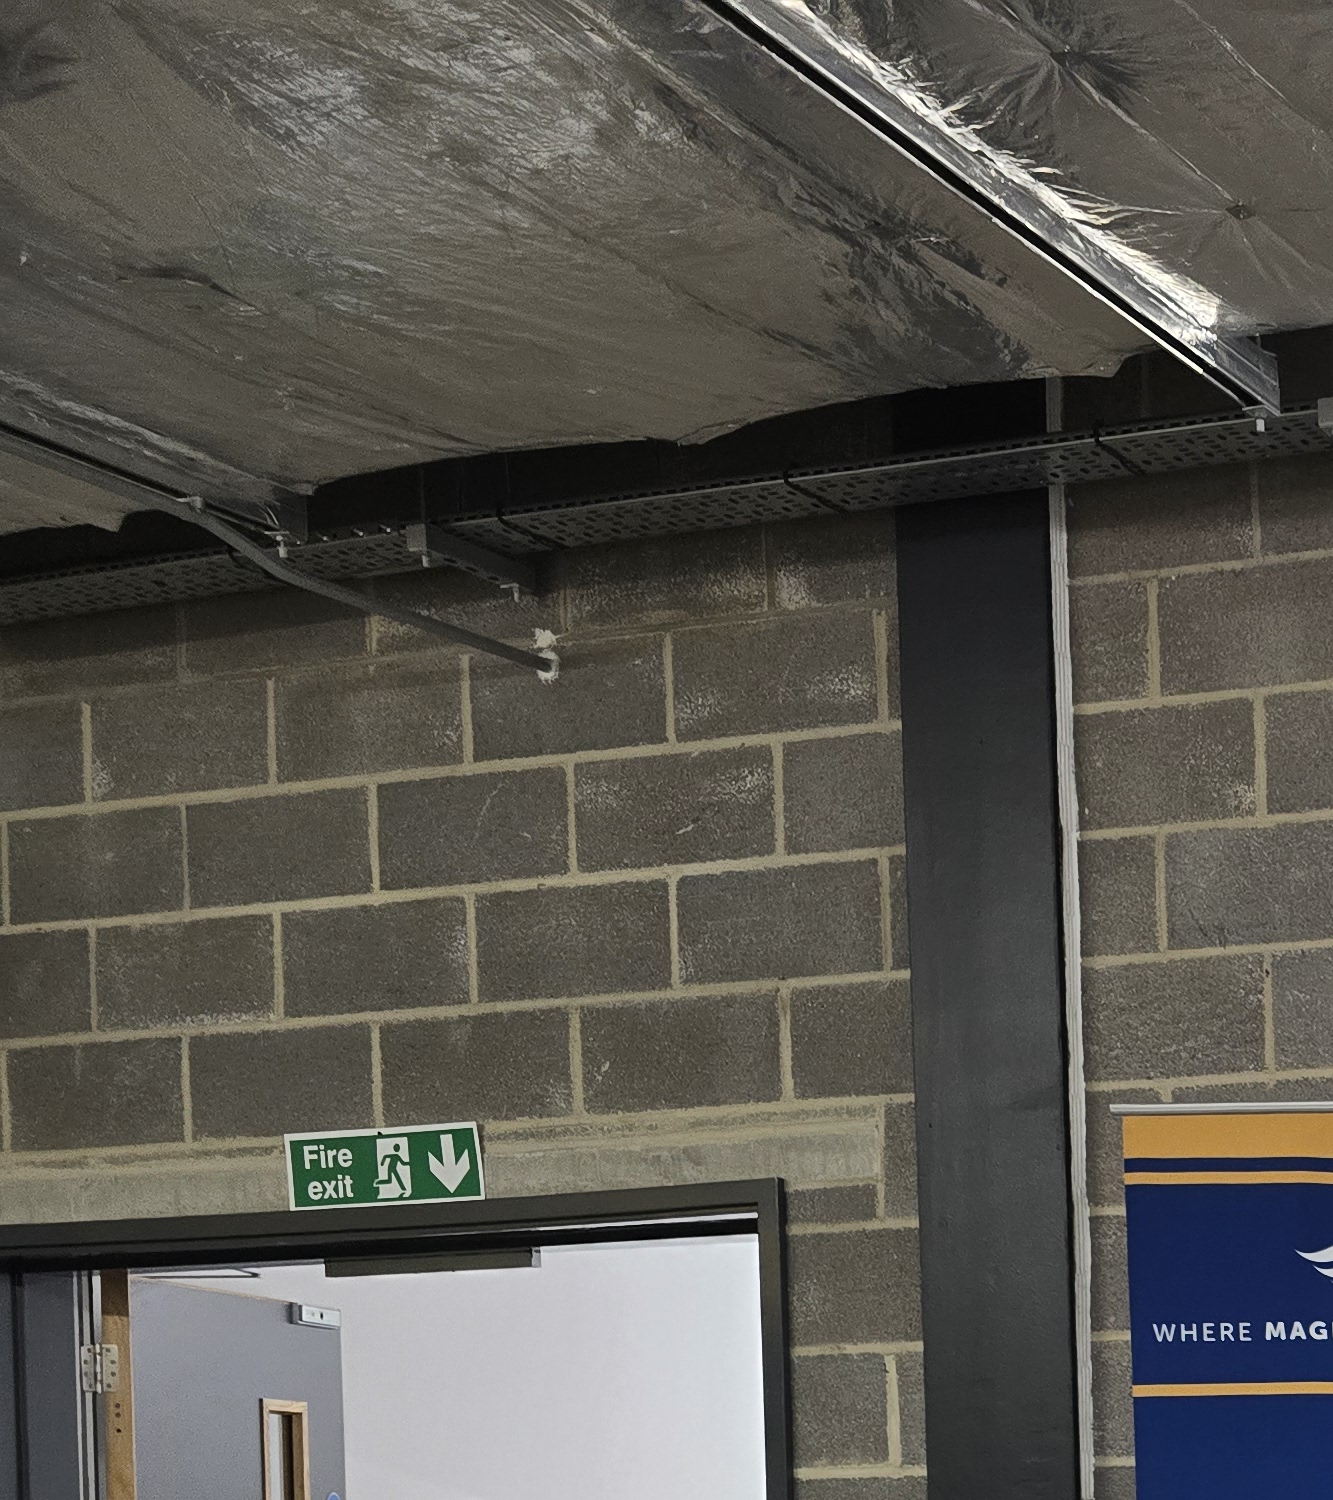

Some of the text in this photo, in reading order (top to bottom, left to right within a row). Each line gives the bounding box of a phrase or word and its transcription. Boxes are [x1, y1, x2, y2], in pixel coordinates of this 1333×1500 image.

[302, 1143, 354, 1170] Fire
[307, 1175, 354, 1200] exit
[1152, 1322, 1252, 1343] WHERE
